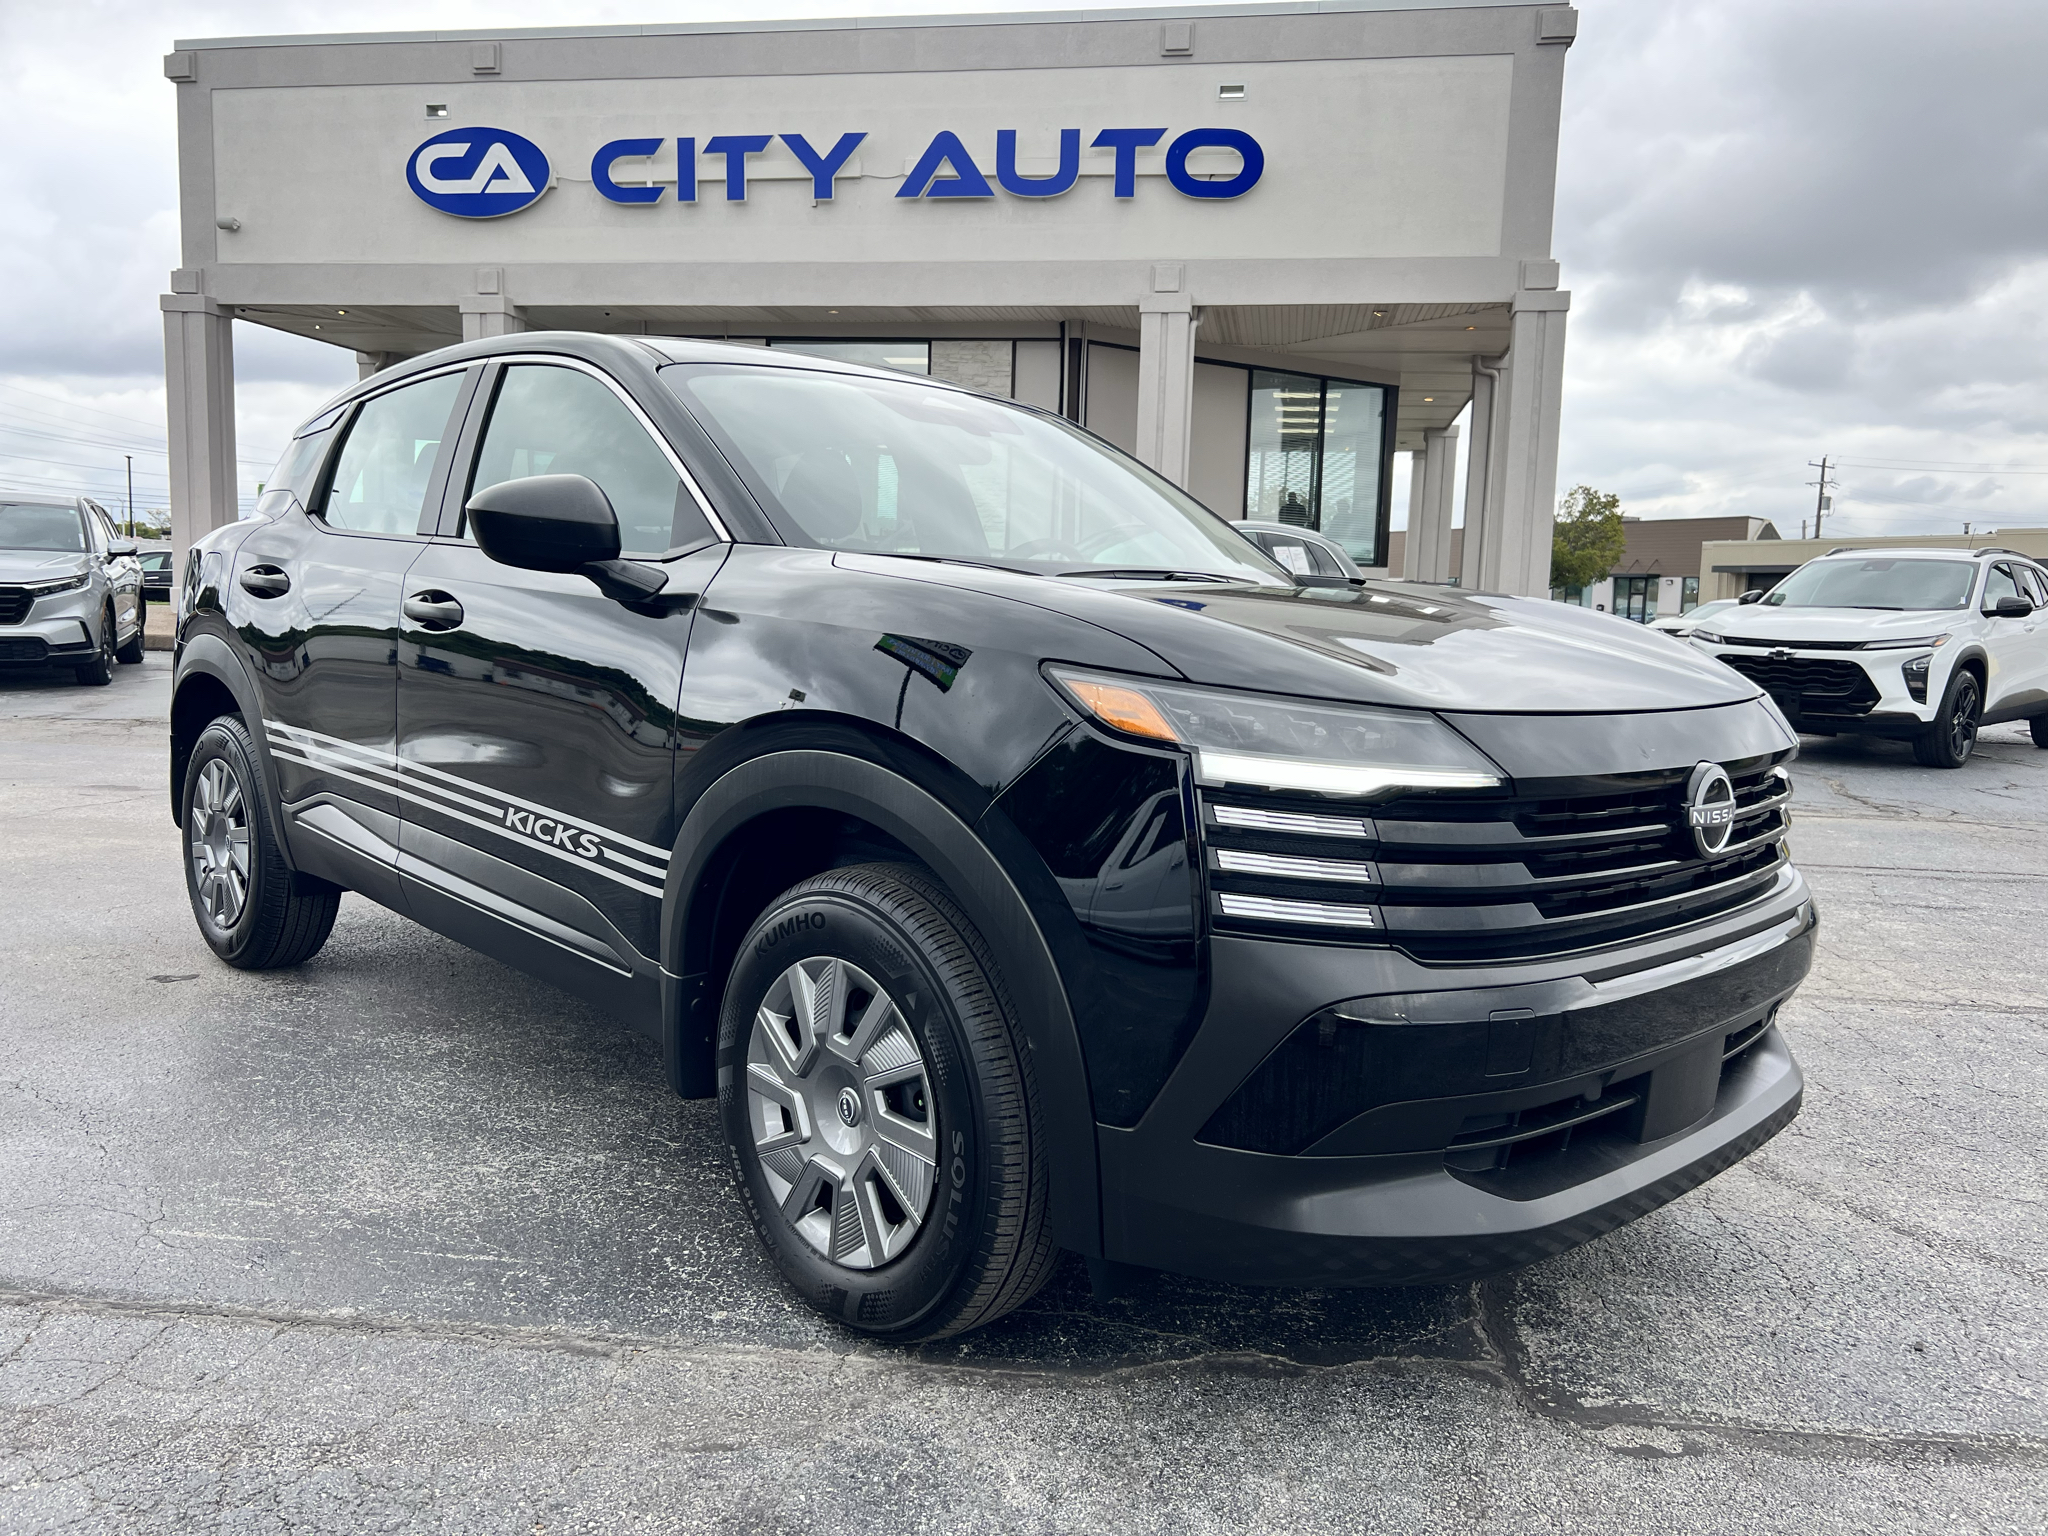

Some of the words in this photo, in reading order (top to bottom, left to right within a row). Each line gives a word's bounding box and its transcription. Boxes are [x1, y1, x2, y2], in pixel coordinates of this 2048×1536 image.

[416, 143, 535, 194] CA
[591, 132, 868, 204] CITY
[895, 128, 1265, 198] AUTO
[505, 806, 601, 858] KICKS
[1692, 808, 1733, 824] NISSA
[753, 911, 827, 961] KUMHO
[935, 1130, 966, 1262] SOLUS
